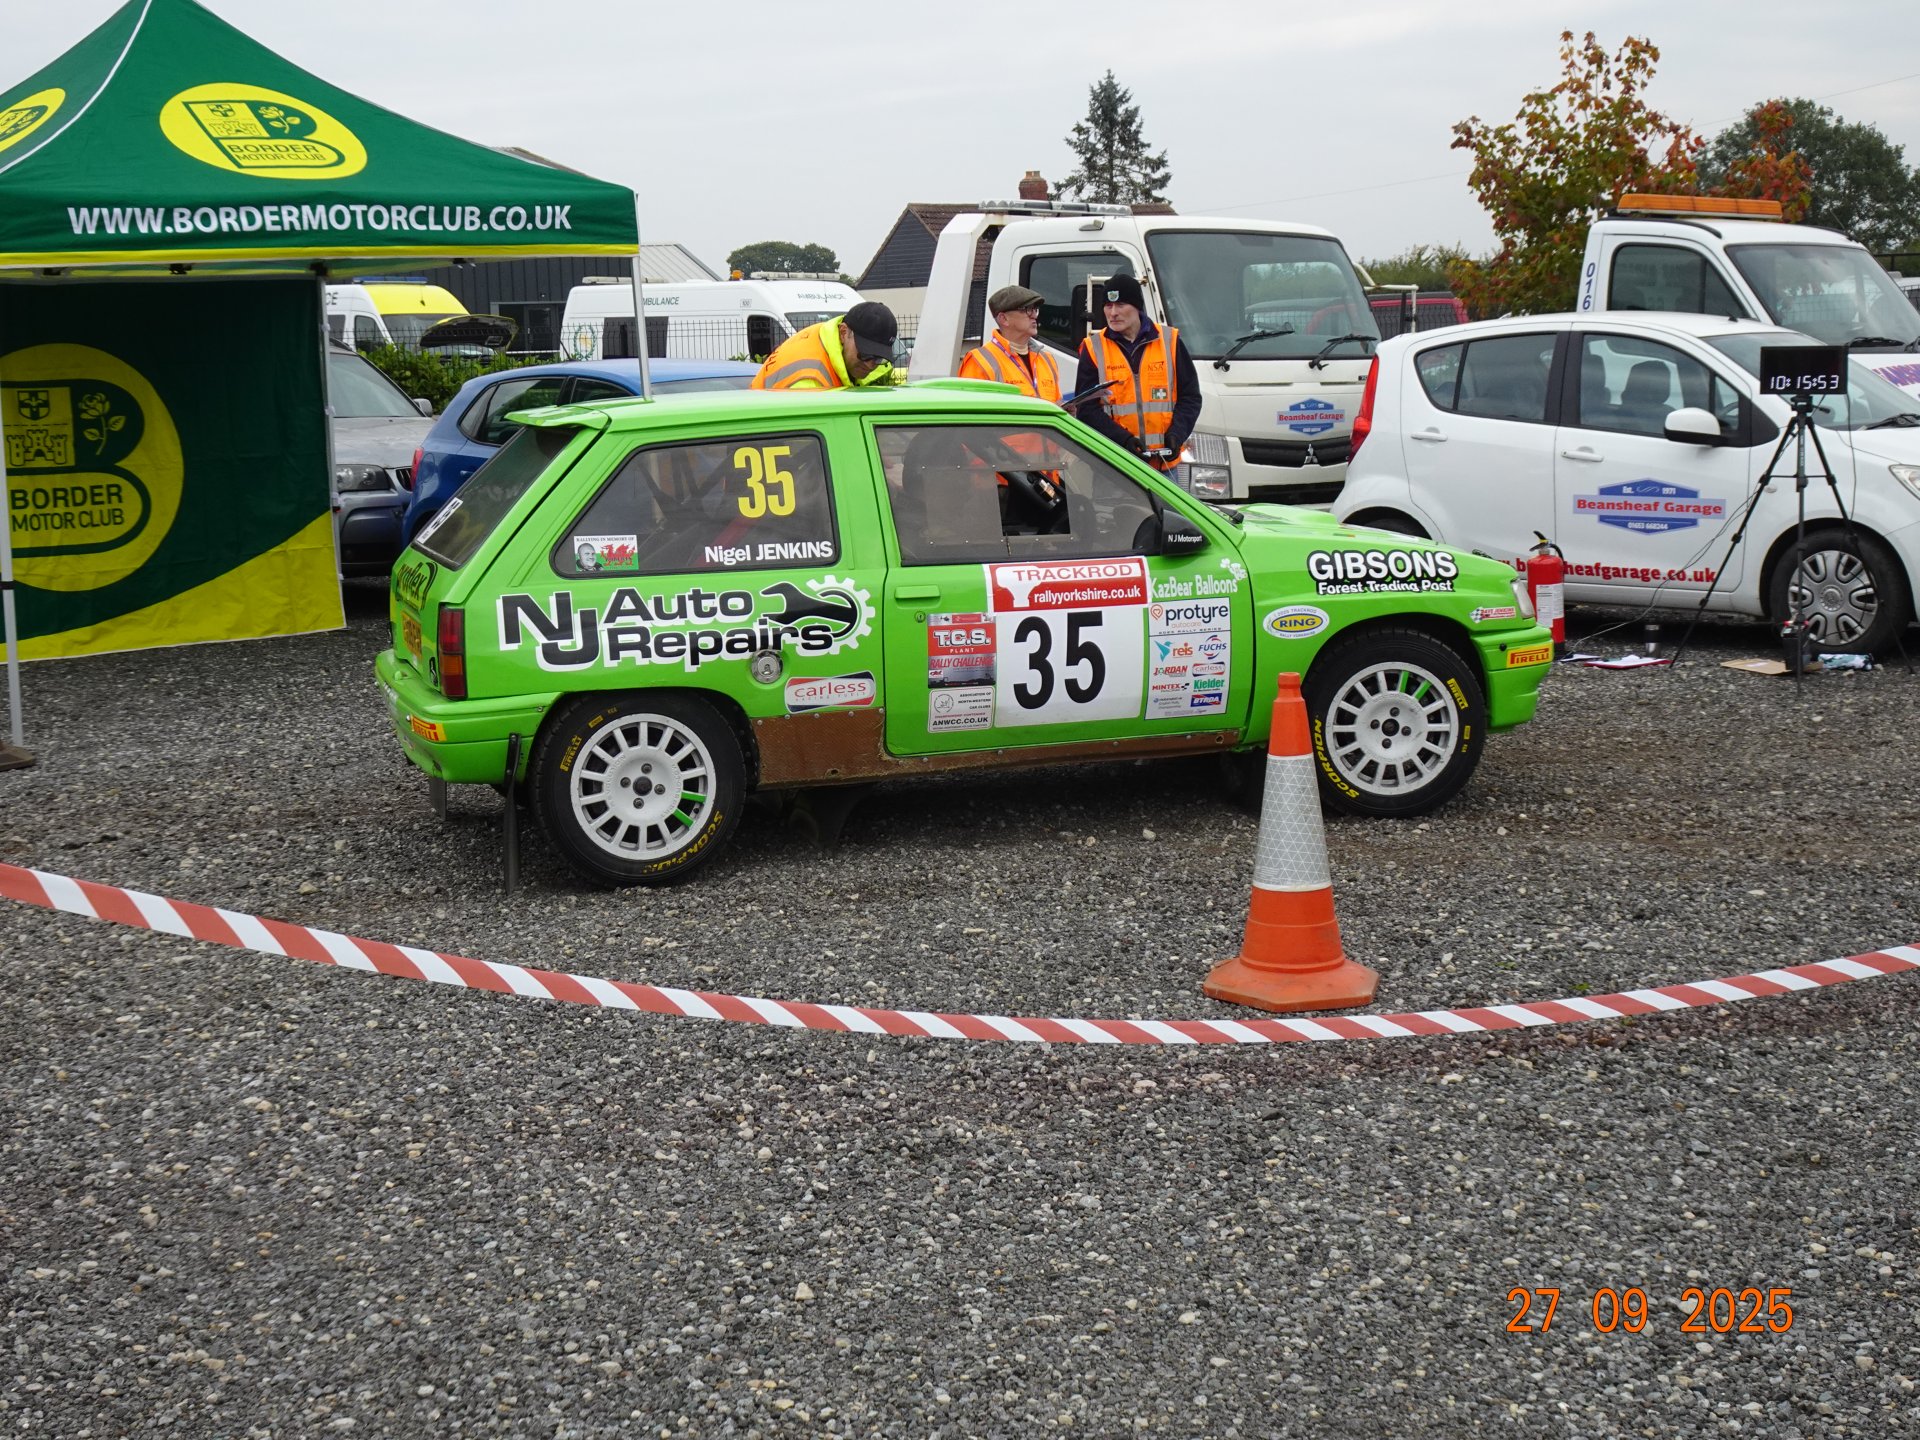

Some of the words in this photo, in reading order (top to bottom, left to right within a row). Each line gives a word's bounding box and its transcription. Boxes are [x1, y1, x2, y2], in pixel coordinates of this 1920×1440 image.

[228, 144, 319, 153] BORDER
[291, 153, 327, 161] CLUB
[67, 204, 572, 235] WWW.BORDERMOTORCLUB.CO.UK
[1582, 262, 1596, 312] 016
[642, 297, 680, 306] MBULANCE
[1770, 375, 1840, 390] 10:15:53
[1278, 413, 1318, 422] Beansheaf
[1319, 412, 1345, 421] Garage
[733, 446, 796, 518] 35
[10, 483, 123, 510] BORDER
[1576, 499, 1660, 513] Beansheaf
[1663, 501, 1723, 516] Garage
[11, 511, 76, 532] MOTOR
[78, 508, 125, 528] CLUB
[1177, 534, 1203, 543] Motorsport
[704, 544, 752, 566] Nigel
[755, 541, 834, 561] JENKINS
[1013, 564, 1133, 582] TRACKROD
[1308, 550, 1459, 581] GIBSONS
[1033, 585, 1142, 605] rallyyorkshire.co.uk
[1149, 576, 1193, 599] KazBear
[1194, 574, 1238, 596] Balloons
[1318, 582, 1365, 595] Forest
[1366, 580, 1420, 593] Trading
[1422, 579, 1453, 591] Post
[603, 586, 754, 625] Auto
[1165, 604, 1229, 627] protyre
[1279, 618, 1317, 628] RING
[500, 590, 600, 666] NJ
[607, 618, 834, 667] Repairs
[933, 628, 992, 648] T.C.S.
[1172, 642, 1194, 657] reis
[1198, 642, 1228, 652] FUCHS
[930, 657, 952, 669] RALLY
[1012, 610, 1107, 710] 35
[1509, 647, 1550, 665] PIRELLI
[1152, 665, 1188, 676] JORDAN
[1194, 664, 1224, 673] carless
[794, 682, 867, 698] carless
[1151, 683, 1181, 691] MINTEX
[1193, 677, 1225, 690] Kielder
[1193, 696, 1219, 704] BTRDA
[1446, 677, 1469, 711] PIRELLI
[932, 717, 989, 726] ANWCC.CO.UK
[1314, 718, 1360, 798] SCORPION
